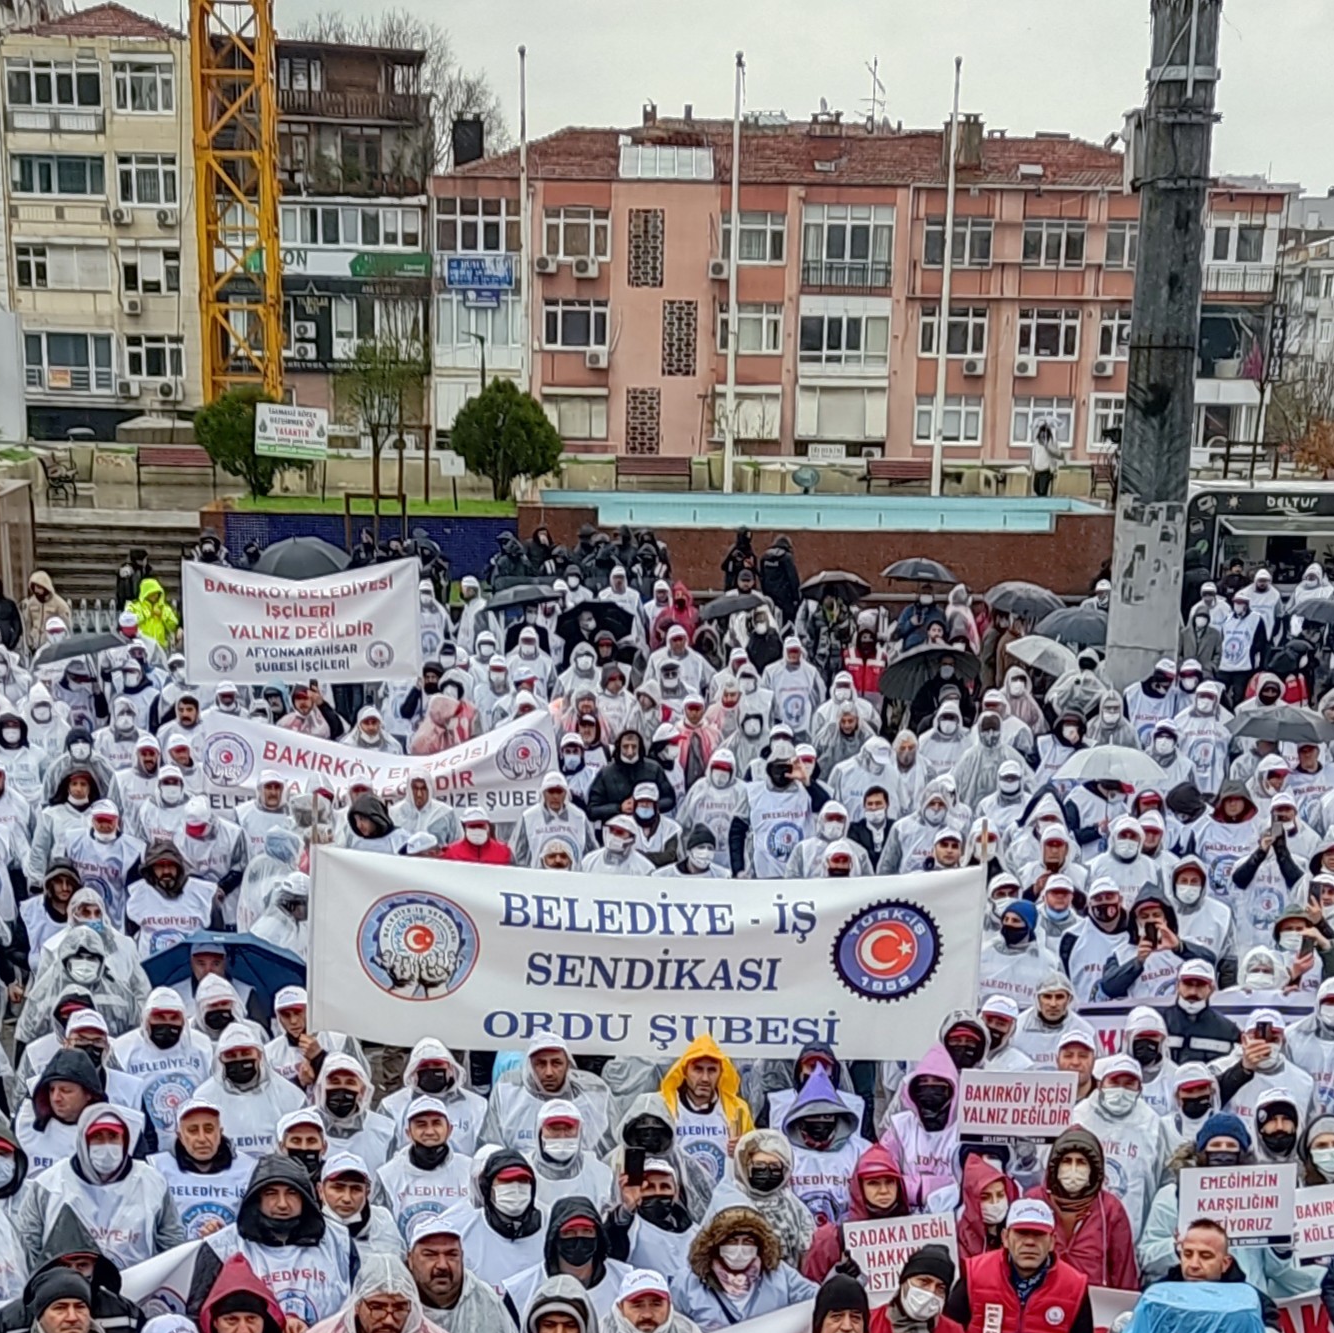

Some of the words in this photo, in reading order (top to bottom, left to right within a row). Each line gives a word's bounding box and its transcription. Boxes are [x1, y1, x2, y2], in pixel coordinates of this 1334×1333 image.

[204, 578, 291, 599] BAKIRKÖY
[297, 576, 393, 600] BELEDİYESİ
[266, 601, 336, 619] İŞÇİLERİ
[228, 624, 289, 640] YALNIZ
[295, 619, 373, 640] DEĞİLDİR
[245, 642, 358, 658] AFYONKARAHİSAR
[255, 658, 298, 674] ŞUBESİ
[301, 657, 350, 672] İŞÇİLERİ
[263, 741, 380, 780] BAKIRKÖY
[485, 790, 537, 812] ŞUBE
[498, 890, 734, 937] BELEDİYE
[774, 893, 816, 944] İŞ
[849, 905, 927, 937] TÜRK-İŞ
[525, 949, 783, 993] SENDİKASI
[860, 973, 912, 991] 1952
[483, 1010, 632, 1040] ORDU
[648, 1010, 840, 1046] ŞUBESİ
[129, 1059, 200, 1074] BELEDİYE-İŞ
[965, 1082, 1031, 1103] BAKIRKÖY
[1034, 1082, 1072, 1107] İŞÇİSİ
[964, 1106, 1008, 1124] YALNIZ
[1011, 1106, 1071, 1125] DEĞİLDİR
[1200, 1170, 1278, 1190] EMEĞİMİZİN
[1197, 1193, 1279, 1214] KARŞILIĞINI
[849, 1226, 908, 1248] SADAKA
[912, 1217, 952, 1240] DEĞİL
[1221, 1217, 1272, 1232] TİYORUZ
